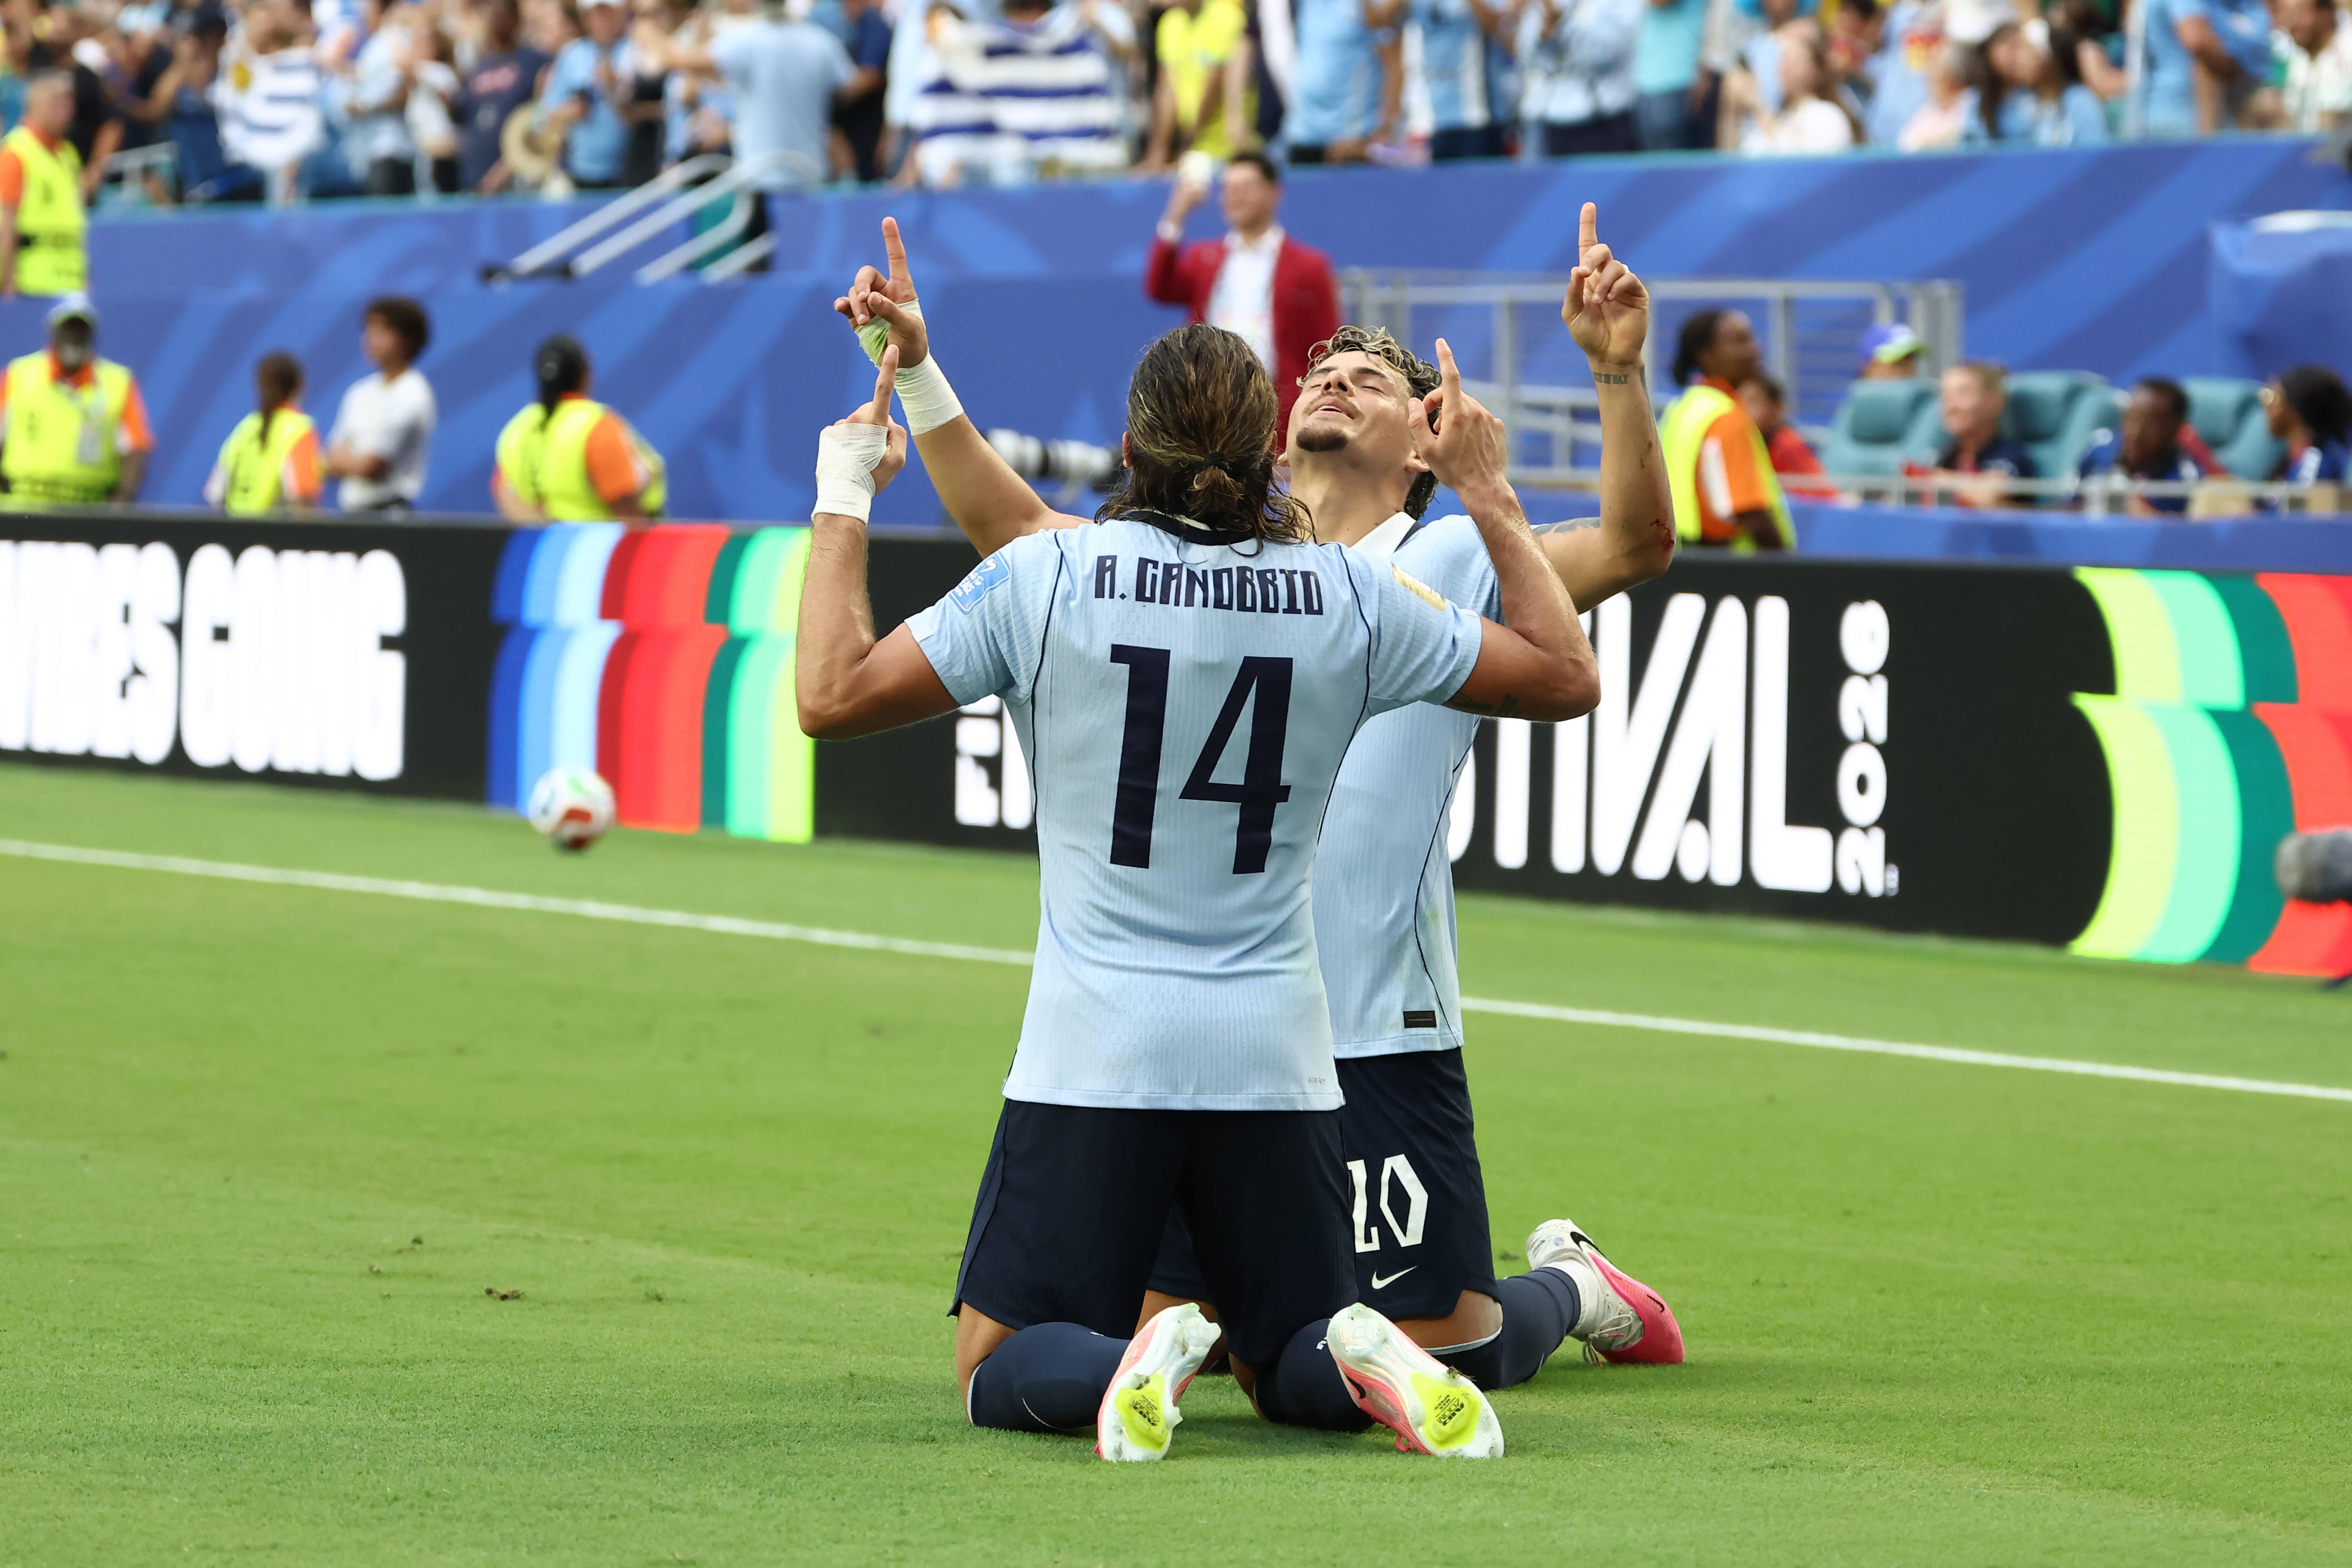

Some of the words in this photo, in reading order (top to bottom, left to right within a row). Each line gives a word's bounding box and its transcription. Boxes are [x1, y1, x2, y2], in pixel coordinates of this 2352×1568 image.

[1094, 555, 1127, 600] A.
[179, 542, 408, 782] GOING
[1110, 644, 1294, 875] 14
[1836, 599, 1890, 897] 2026
[1346, 1153, 1428, 1253] 10
[1437, 1399, 1459, 1423] ZOOM
[1442, 1403, 1464, 1426] AIR
